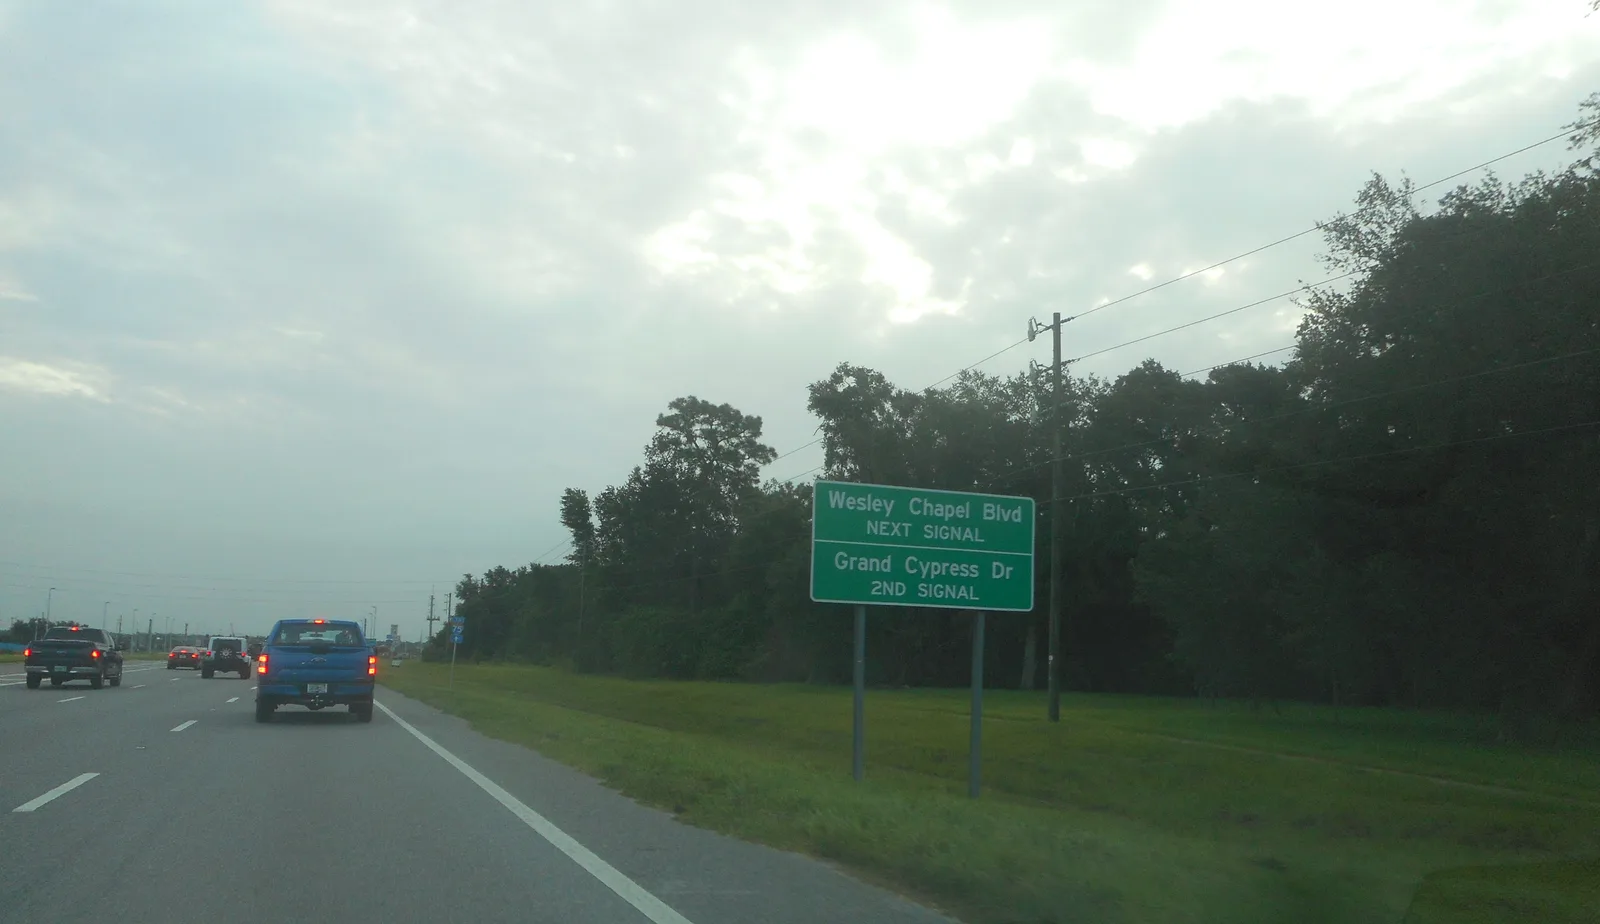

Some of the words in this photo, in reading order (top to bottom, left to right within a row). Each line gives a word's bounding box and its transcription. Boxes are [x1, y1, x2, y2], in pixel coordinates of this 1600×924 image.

[828, 490, 895, 517] Wesley
[908, 497, 971, 521] Chapel
[983, 503, 1022, 523] Blvd
[867, 520, 912, 537] NEXT
[923, 525, 985, 543] SIGNAL
[834, 552, 892, 573] Grand
[905, 556, 980, 579] Cypress
[991, 561, 1014, 579] Dr
[870, 581, 907, 596] 2ND
[917, 583, 980, 600] SIGNAL
